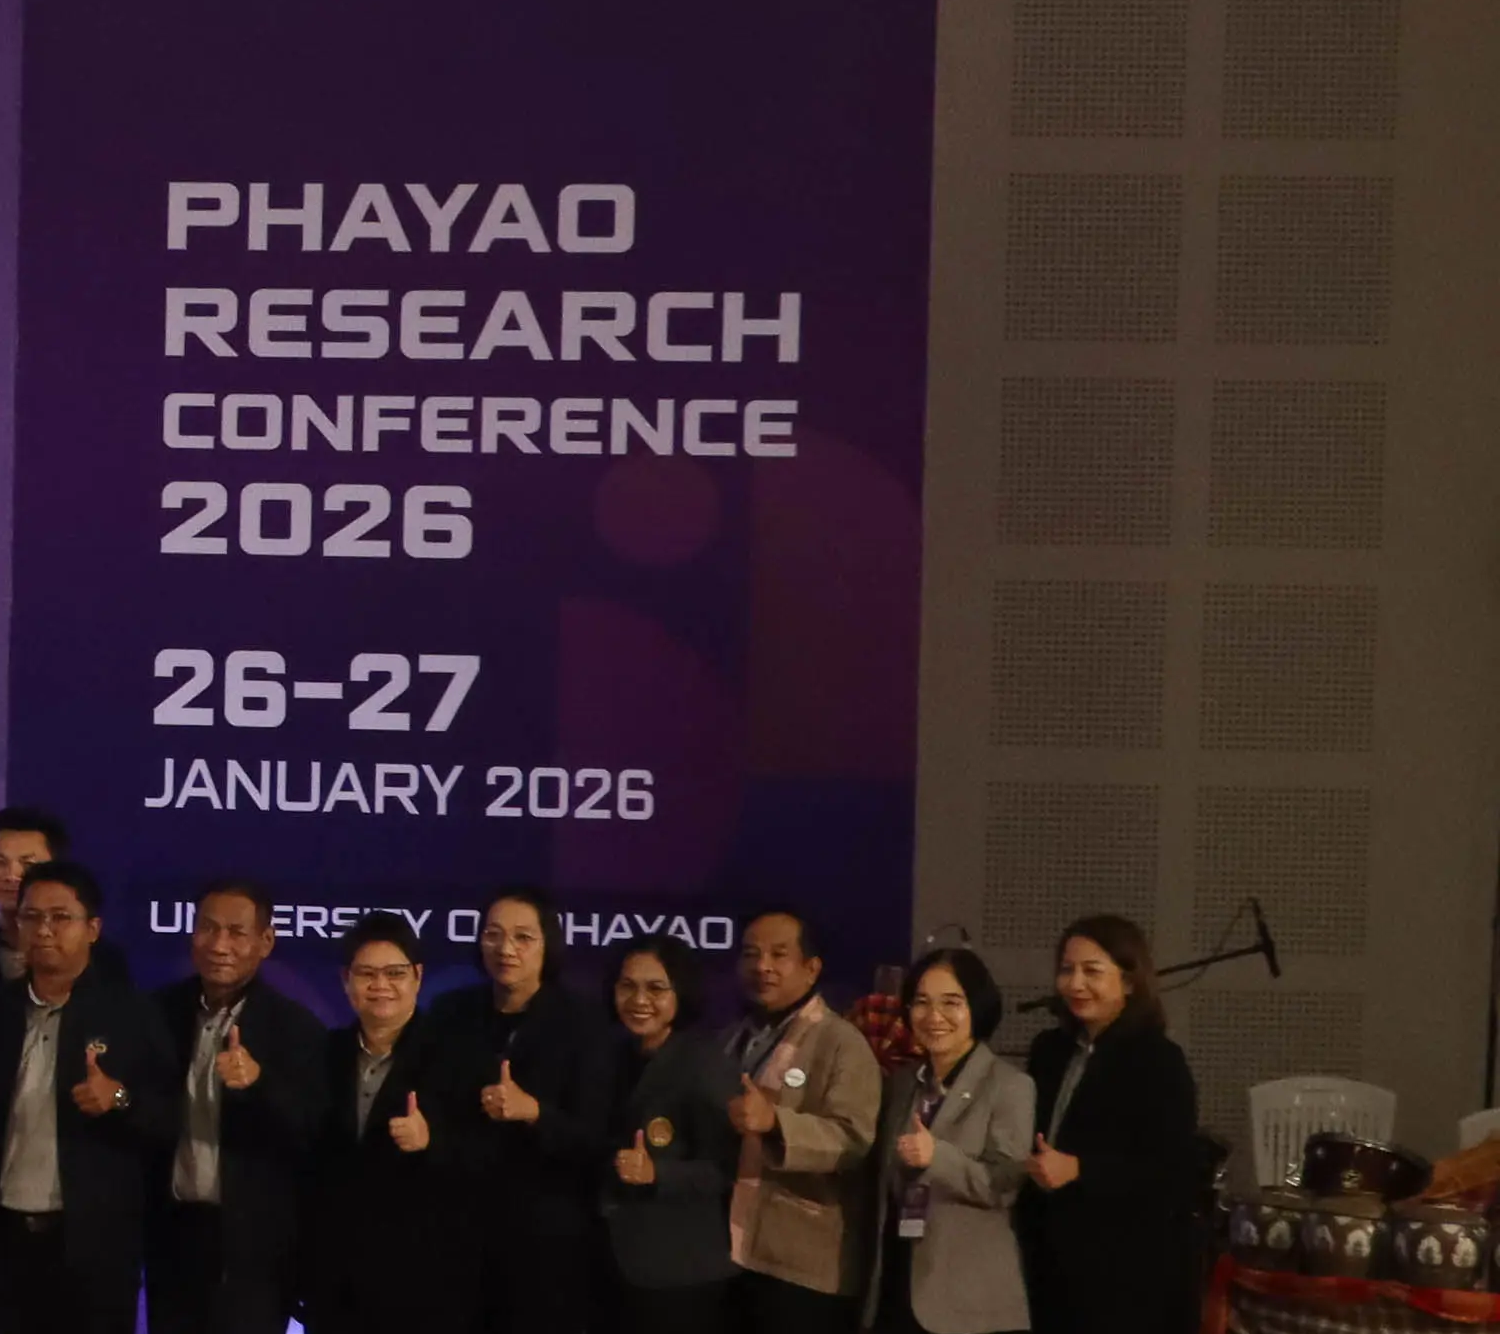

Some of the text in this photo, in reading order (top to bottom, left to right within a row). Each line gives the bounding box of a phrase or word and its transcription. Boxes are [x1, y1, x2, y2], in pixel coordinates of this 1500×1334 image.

[167, 181, 636, 254] PHAYAO
[164, 287, 802, 364] RESEARCH
[162, 392, 799, 458] CONFERENCE
[160, 481, 474, 560] 2026
[144, 757, 656, 821] JANUARY 2026
[556, 910, 735, 951] HAYAO
